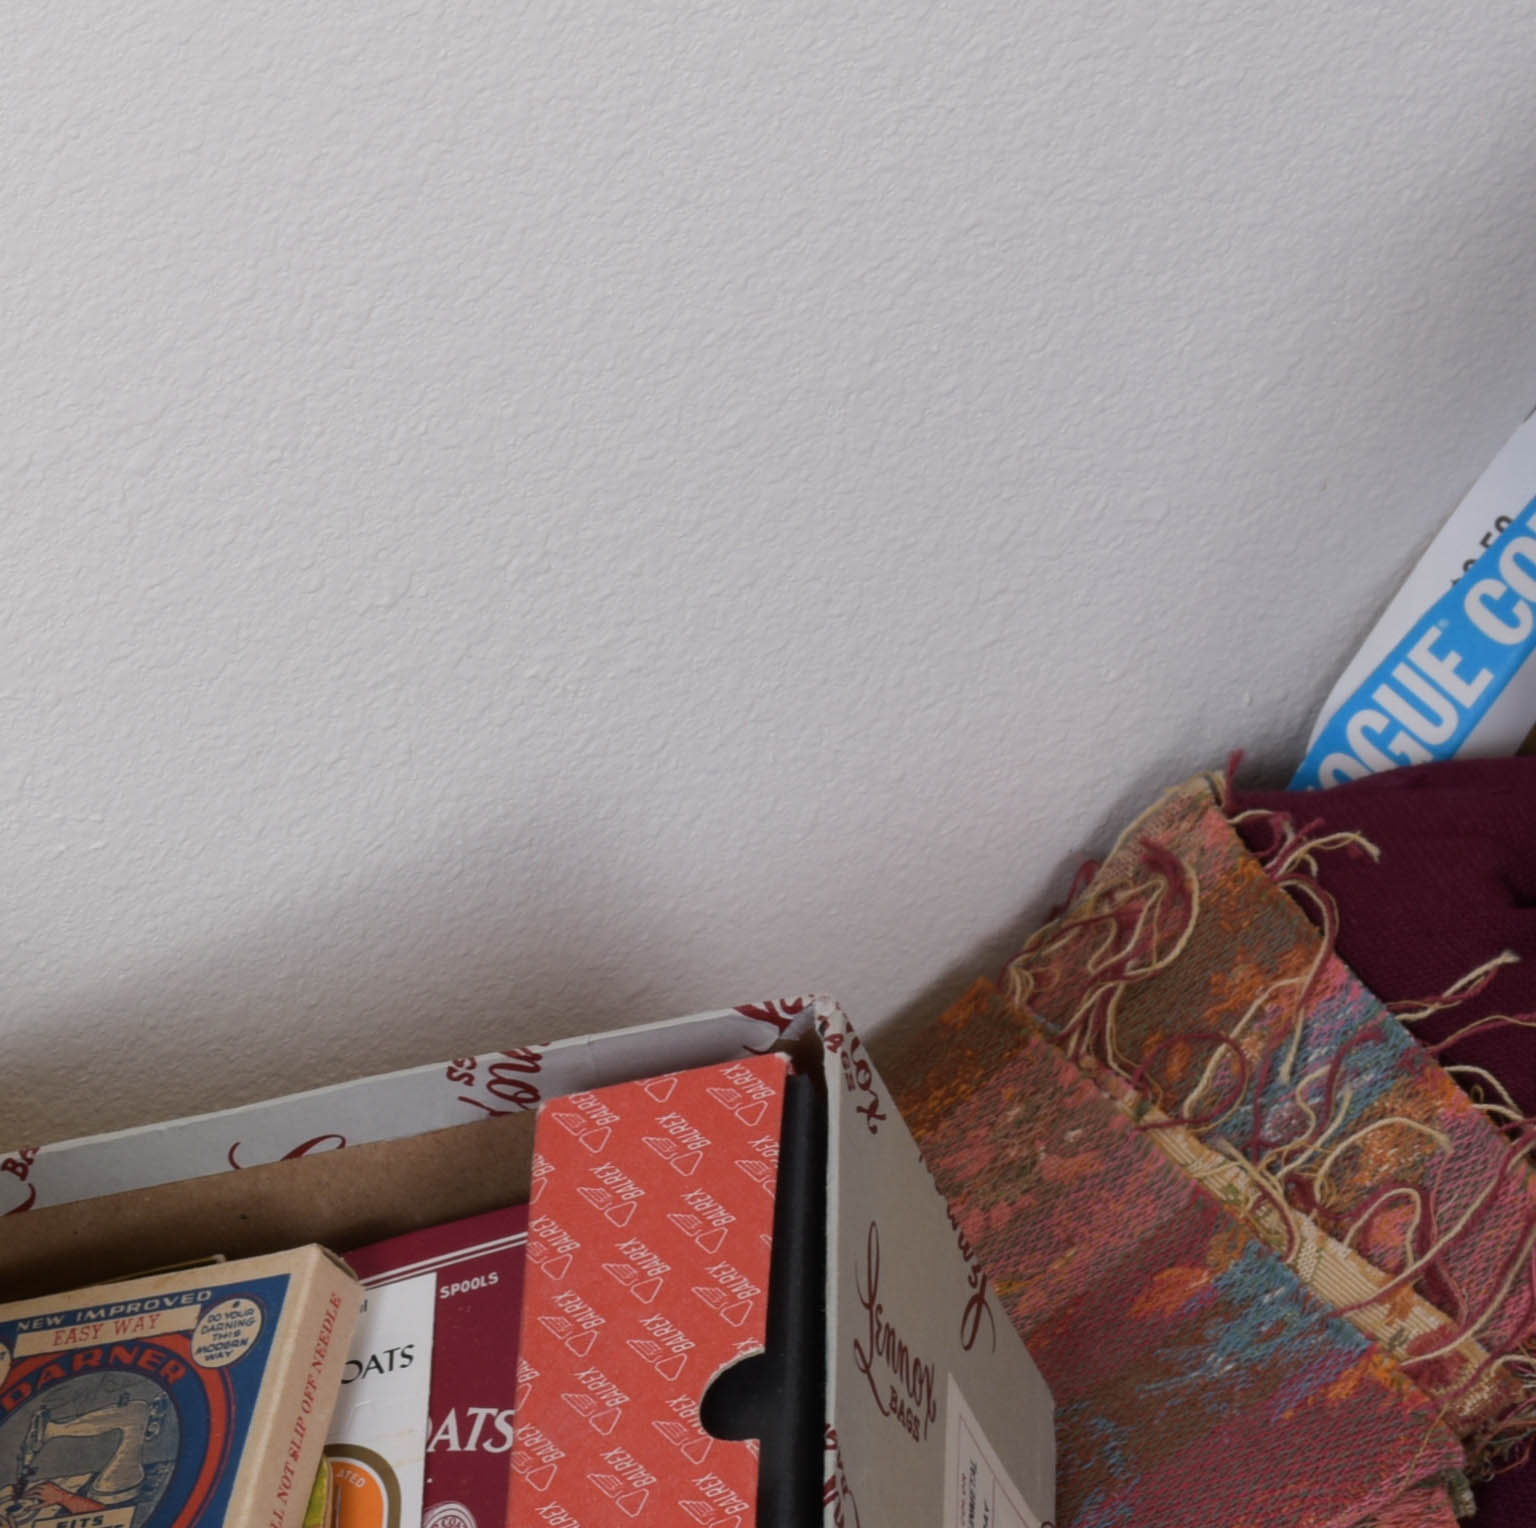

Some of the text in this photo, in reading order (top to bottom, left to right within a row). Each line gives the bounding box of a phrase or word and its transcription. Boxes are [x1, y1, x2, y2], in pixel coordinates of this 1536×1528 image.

[720, 1063, 777, 1101] BALREX
[655, 1112, 712, 1150] BALREX
[590, 1161, 646, 1200] BALREX
[680, 1188, 737, 1227] BALREX
[529, 1215, 581, 1253] BALREX
[616, 1237, 672, 1277] BALREX
[439, 1271, 500, 1300] SPOOLS
[704, 1260, 761, 1299] BALREX
[16, 1289, 213, 1332] NEW IMPROVED
[552, 1290, 606, 1329] BALREX
[51, 1313, 164, 1347] EASY WAY
[310, 1292, 344, 1374] NEEDLE
[639, 1313, 696, 1353] BALREX
[856, 1221, 937, 1441] Lennox
[0, 1345, 189, 1414] DARNER
[299, 1375, 321, 1415] OFF
[575, 1367, 630, 1406] BALREX
[288, 1416, 311, 1463] SLIP
[516, 1424, 566, 1463] BALREX
[276, 1464, 297, 1507] NOT
[600, 1447, 657, 1487] BALREX
[693, 1472, 750, 1515] BALREX
